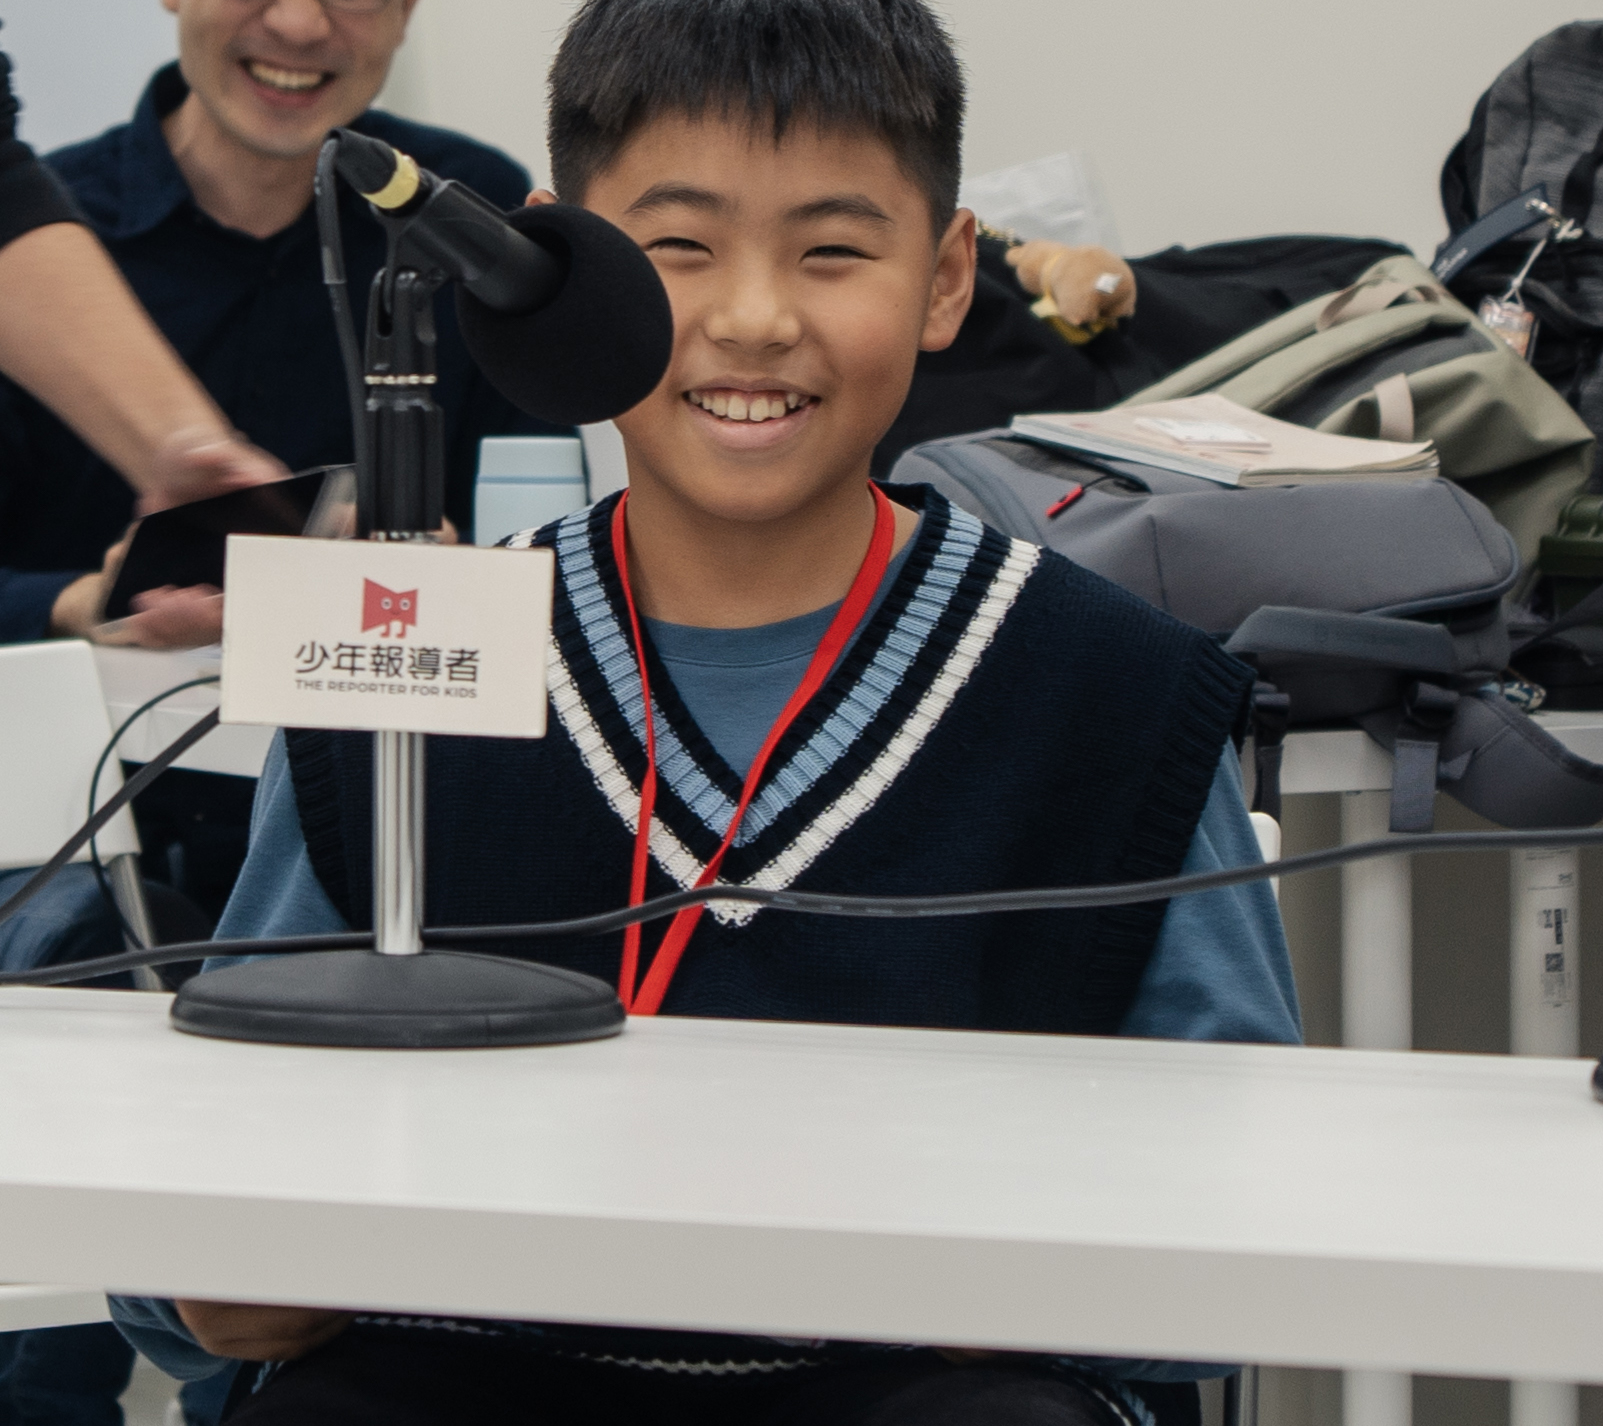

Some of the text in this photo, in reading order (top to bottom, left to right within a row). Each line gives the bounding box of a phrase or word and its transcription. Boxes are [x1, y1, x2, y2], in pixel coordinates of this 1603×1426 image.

[294, 640, 480, 683] 少年報導者
[295, 679, 477, 698] THE REPORTER FOR KIDS
